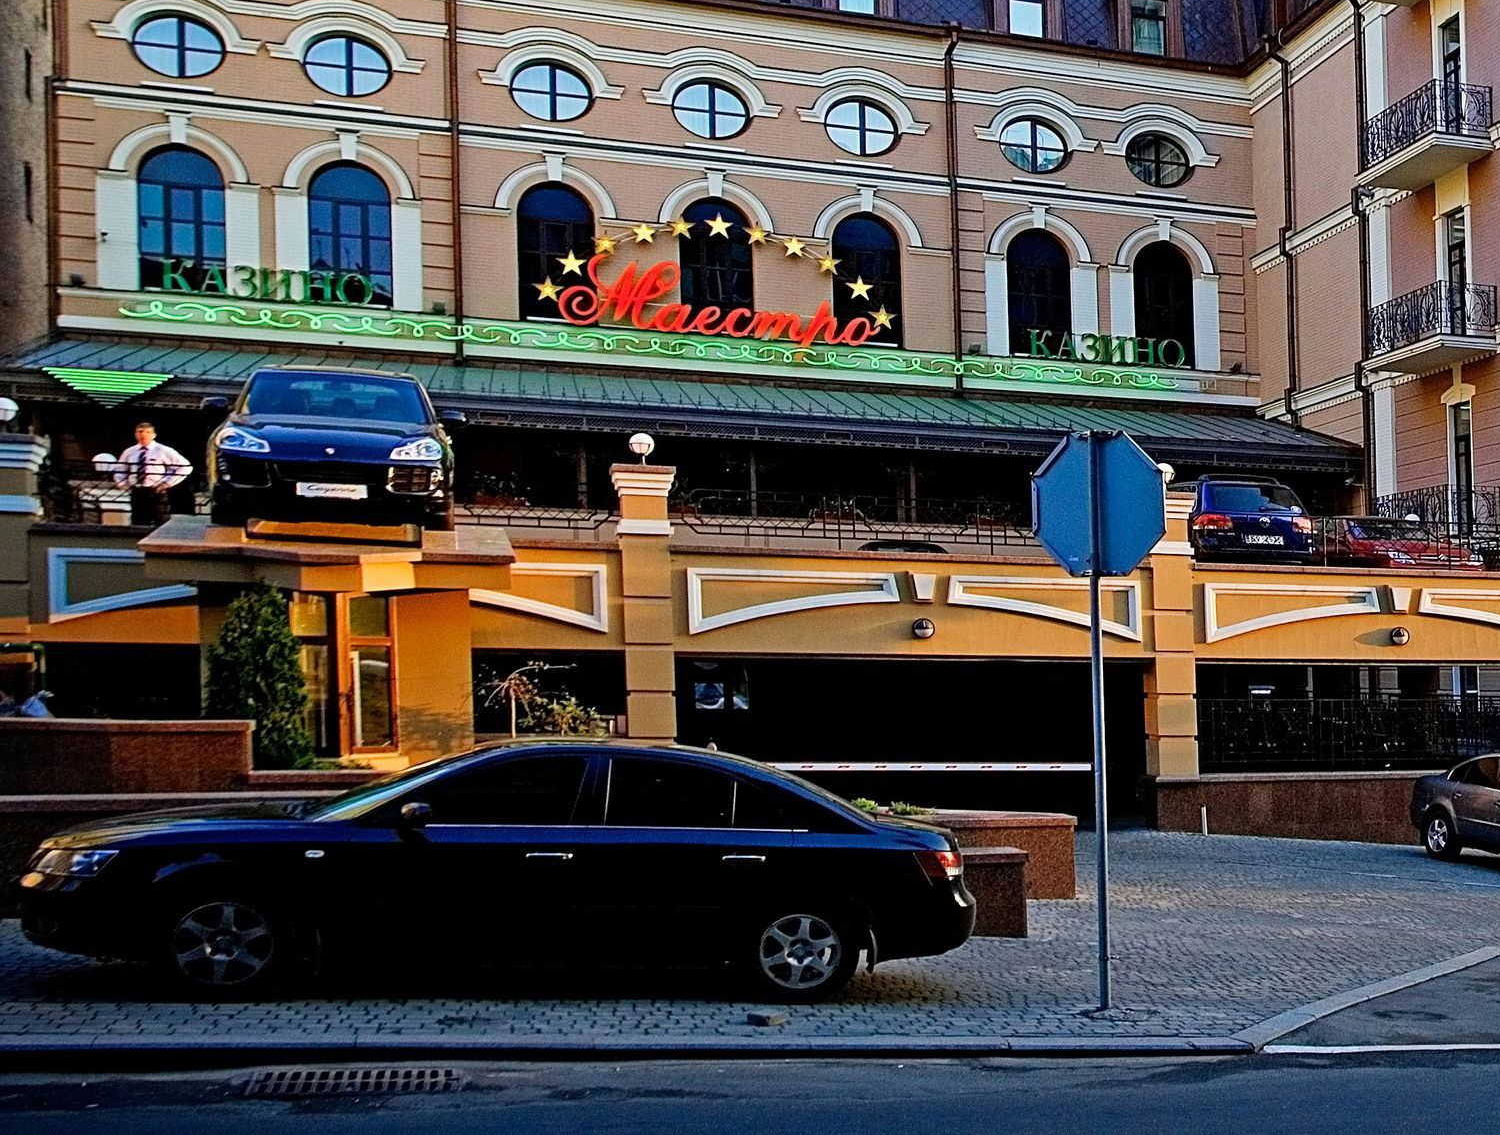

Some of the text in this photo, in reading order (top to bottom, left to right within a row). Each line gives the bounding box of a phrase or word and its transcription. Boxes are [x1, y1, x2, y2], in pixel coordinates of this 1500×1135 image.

[161, 258, 373, 305] КАЗИНО
[558, 253, 881, 349] Маестро
[1027, 328, 1186, 367] КАЗИНО
[306, 484, 357, 494] Cayenne
